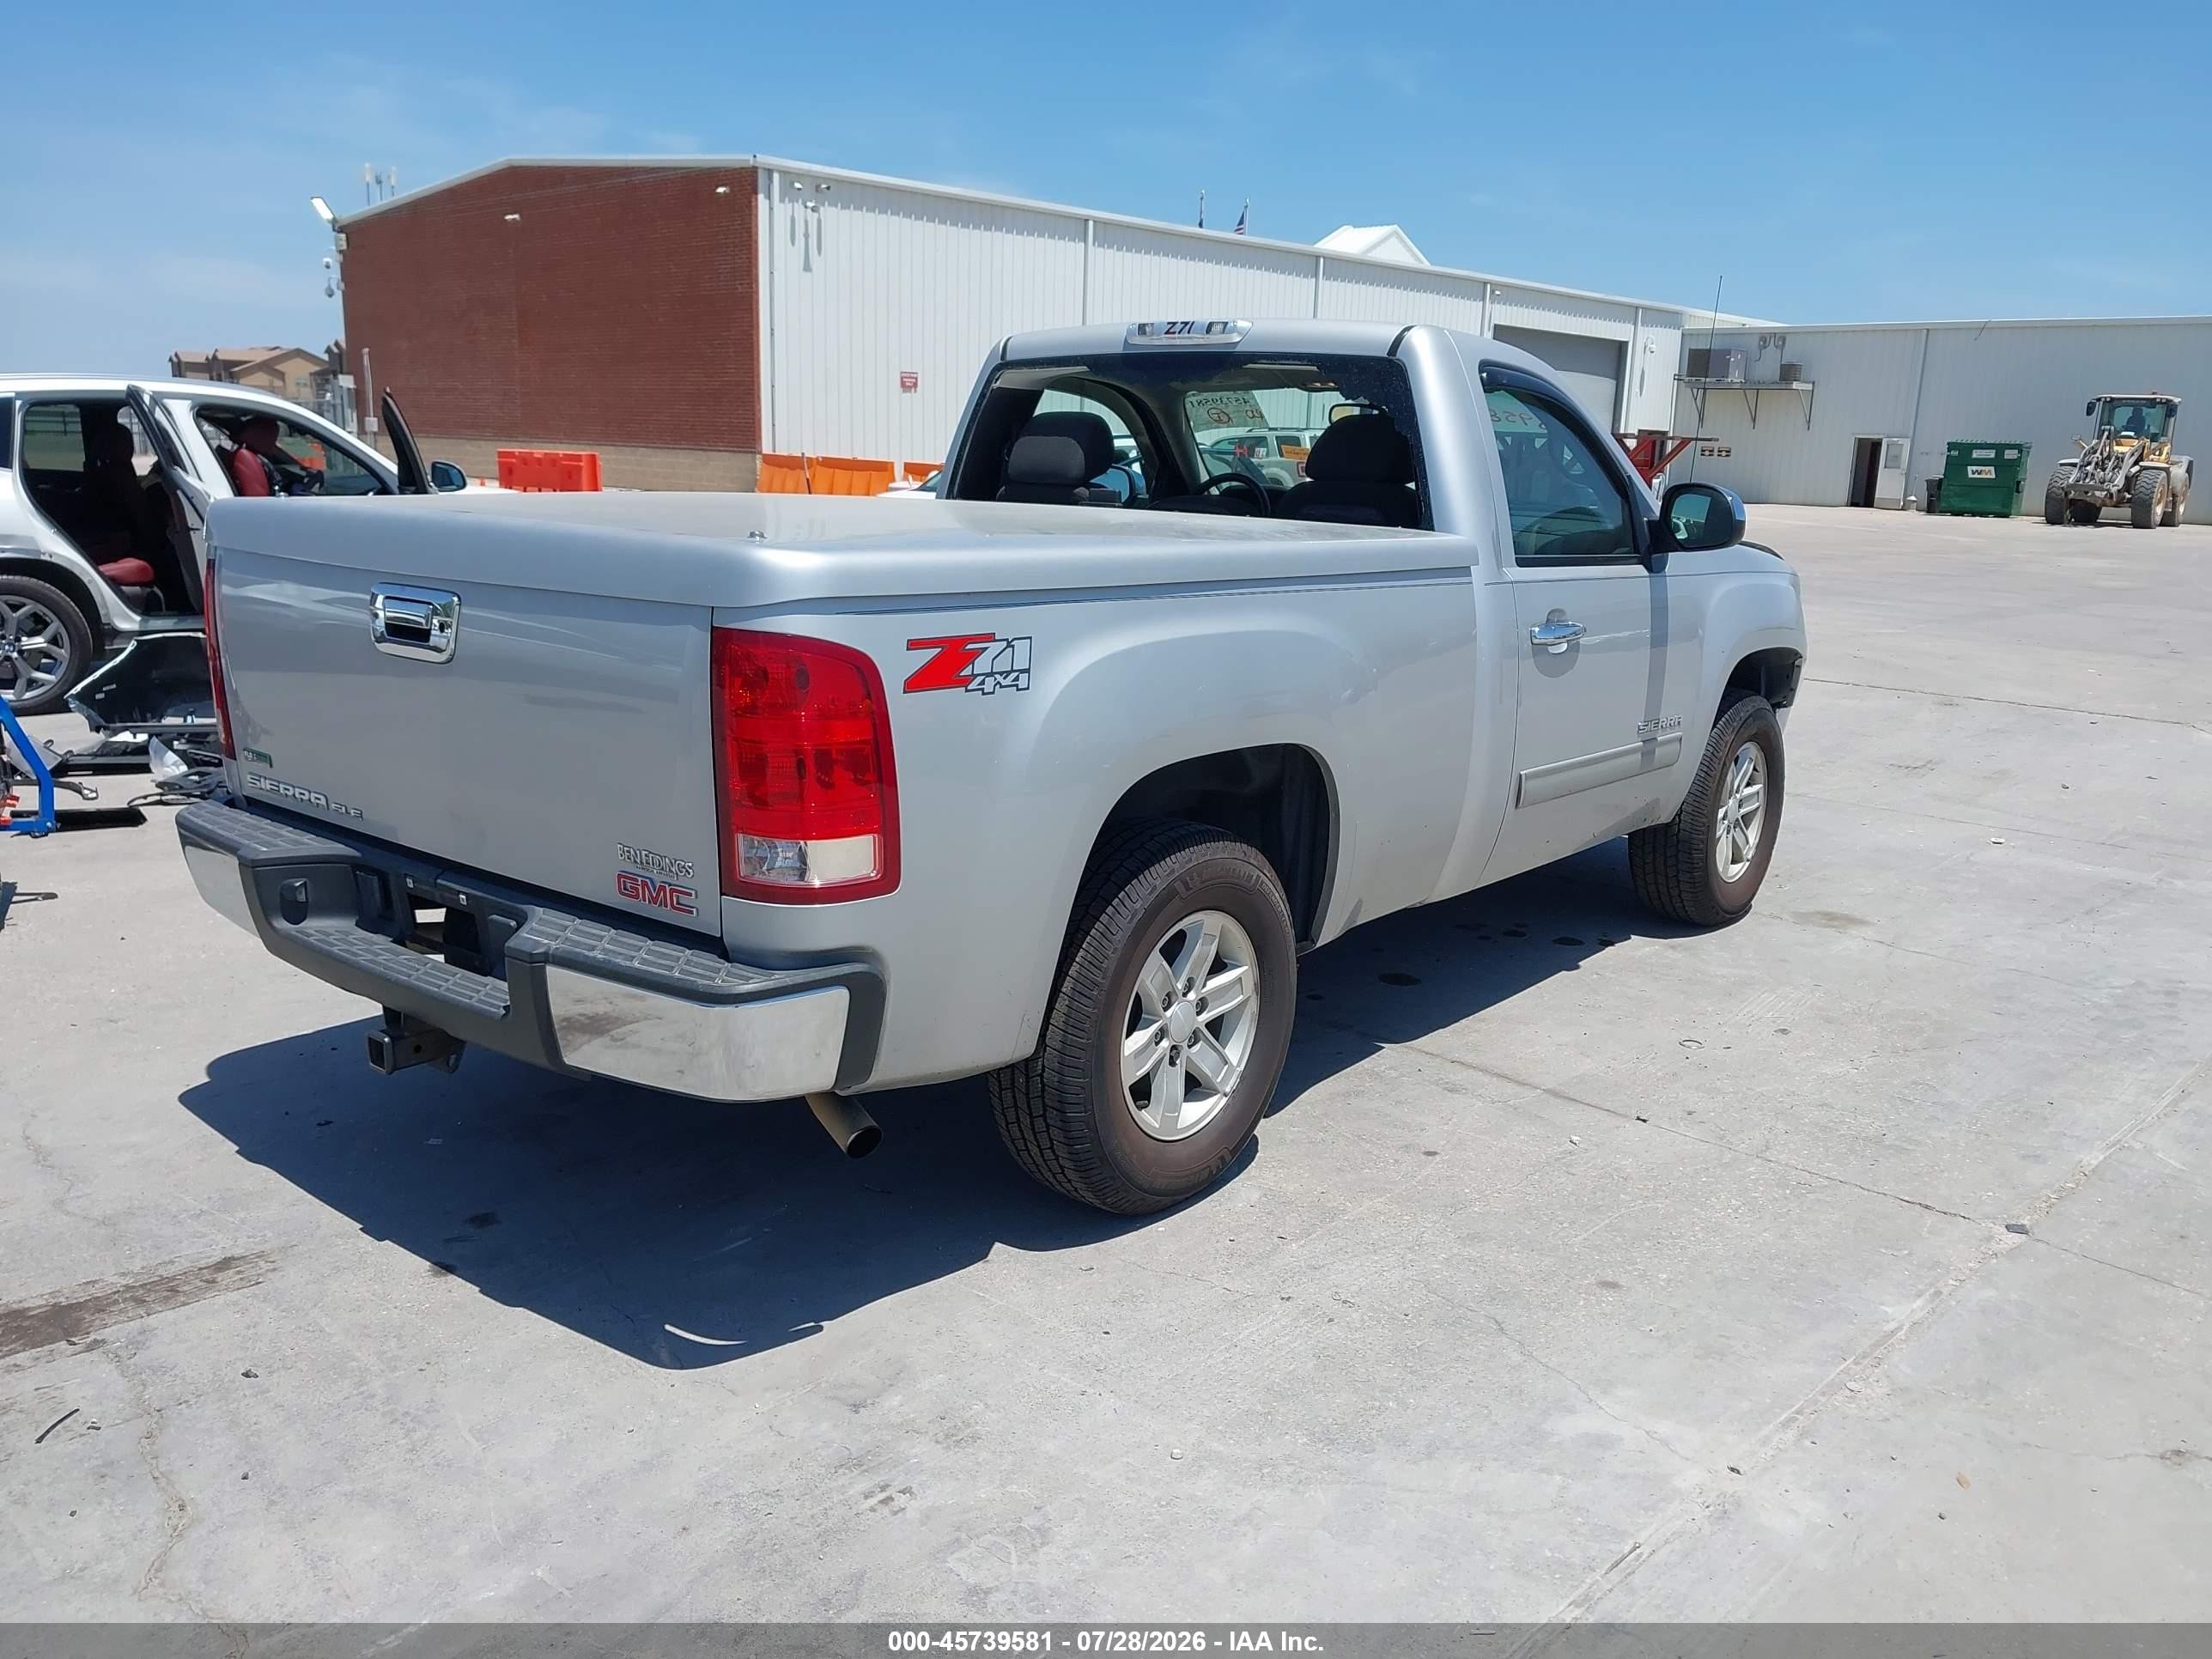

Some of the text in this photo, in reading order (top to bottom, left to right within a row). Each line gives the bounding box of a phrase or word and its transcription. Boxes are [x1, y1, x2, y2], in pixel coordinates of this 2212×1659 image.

[1164, 320, 1195, 335] Z71
[903, 633, 1032, 694] Z71
[1638, 714, 1683, 734] SIERRA
[246, 772, 330, 810] SIERRA
[617, 872, 698, 917] GMC
